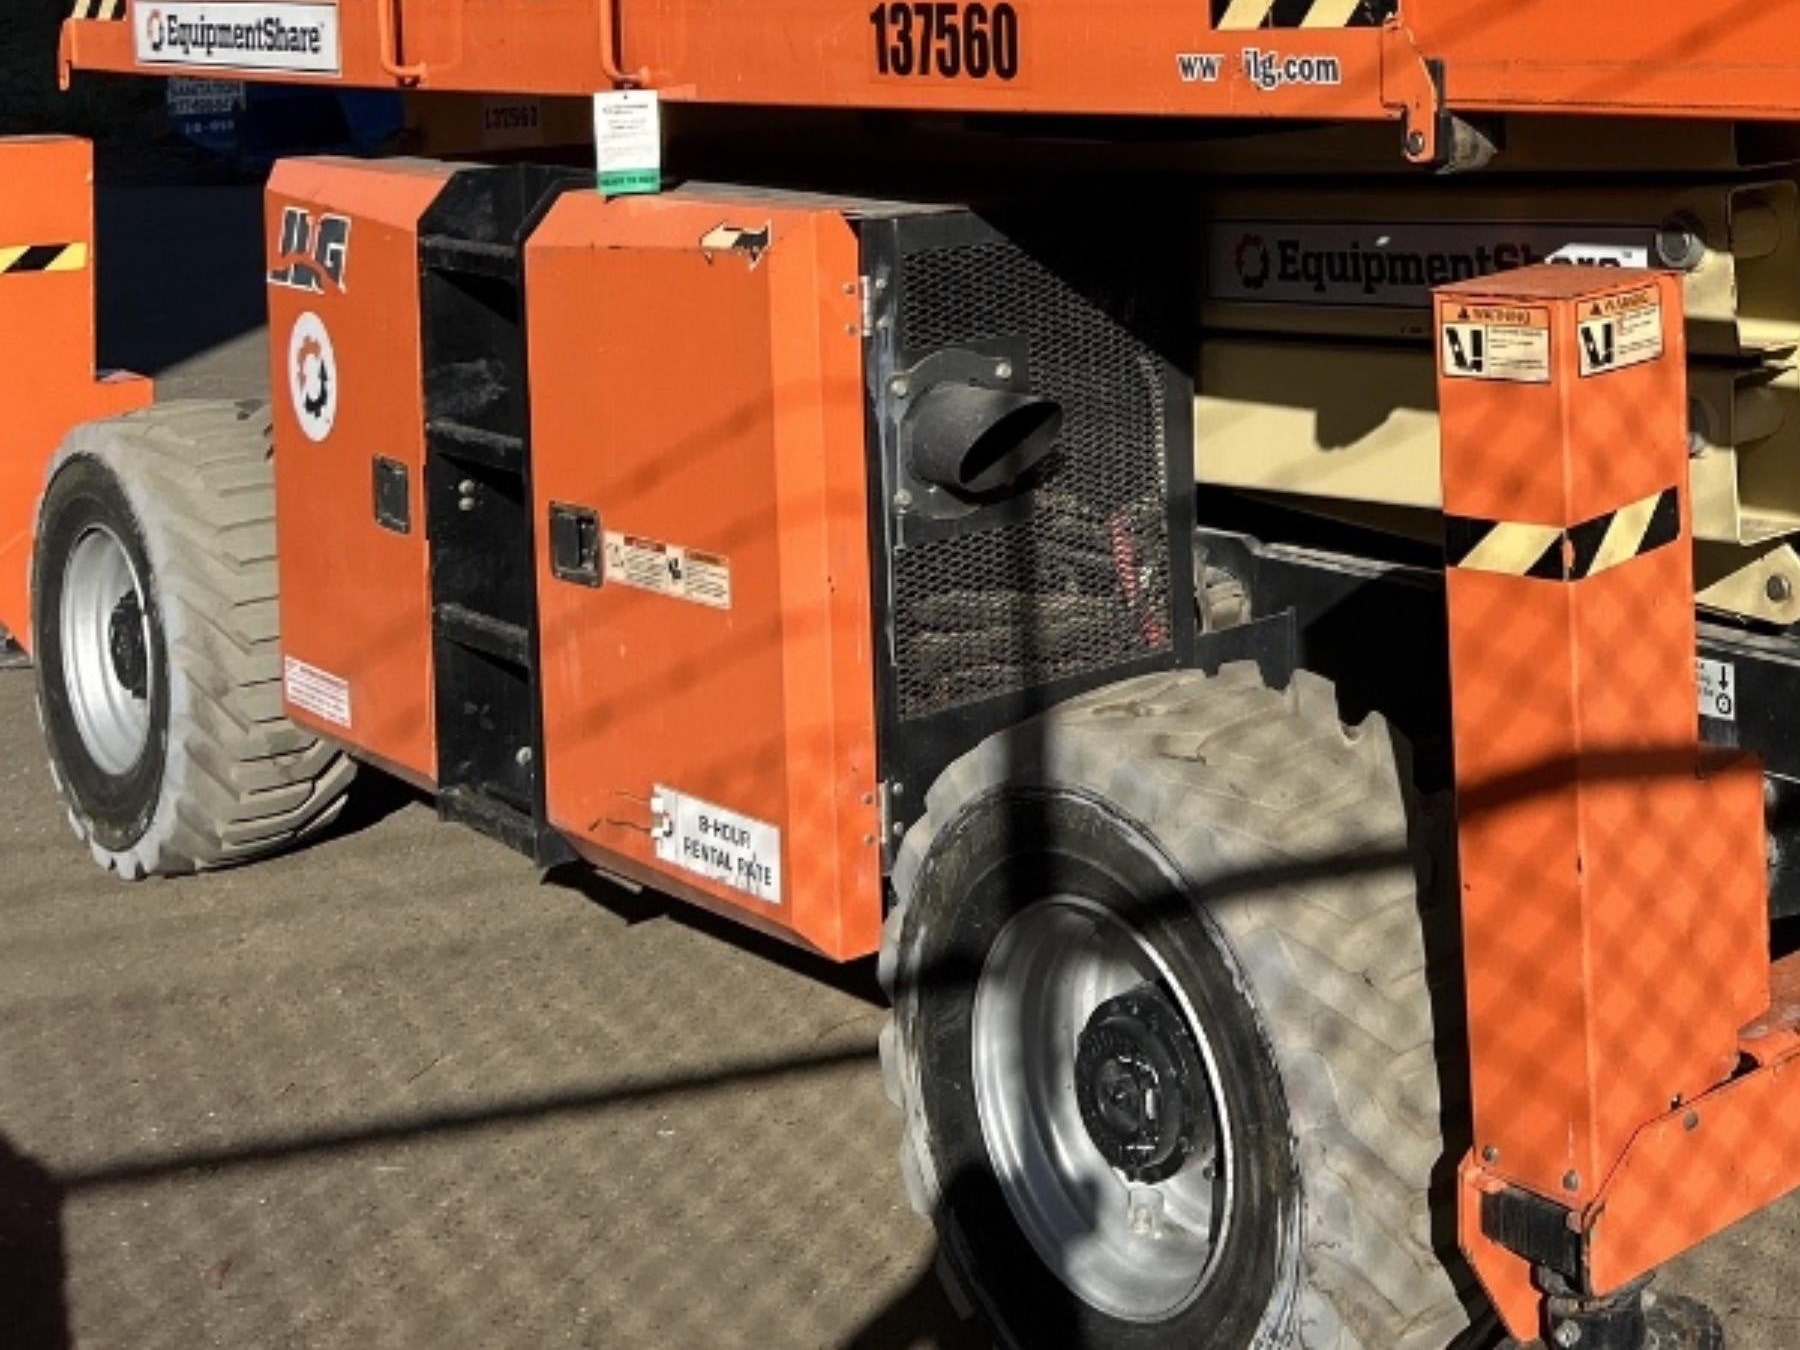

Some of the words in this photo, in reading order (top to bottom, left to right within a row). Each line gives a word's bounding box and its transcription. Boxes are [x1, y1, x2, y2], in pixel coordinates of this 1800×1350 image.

[166, 14, 321, 56] EquipmentShare
[870, 2, 1018, 81] 137560
[1276, 238, 1622, 294] EquipmentS
[683, 836, 733, 871] RENTAL
[737, 857, 772, 886] RATE
